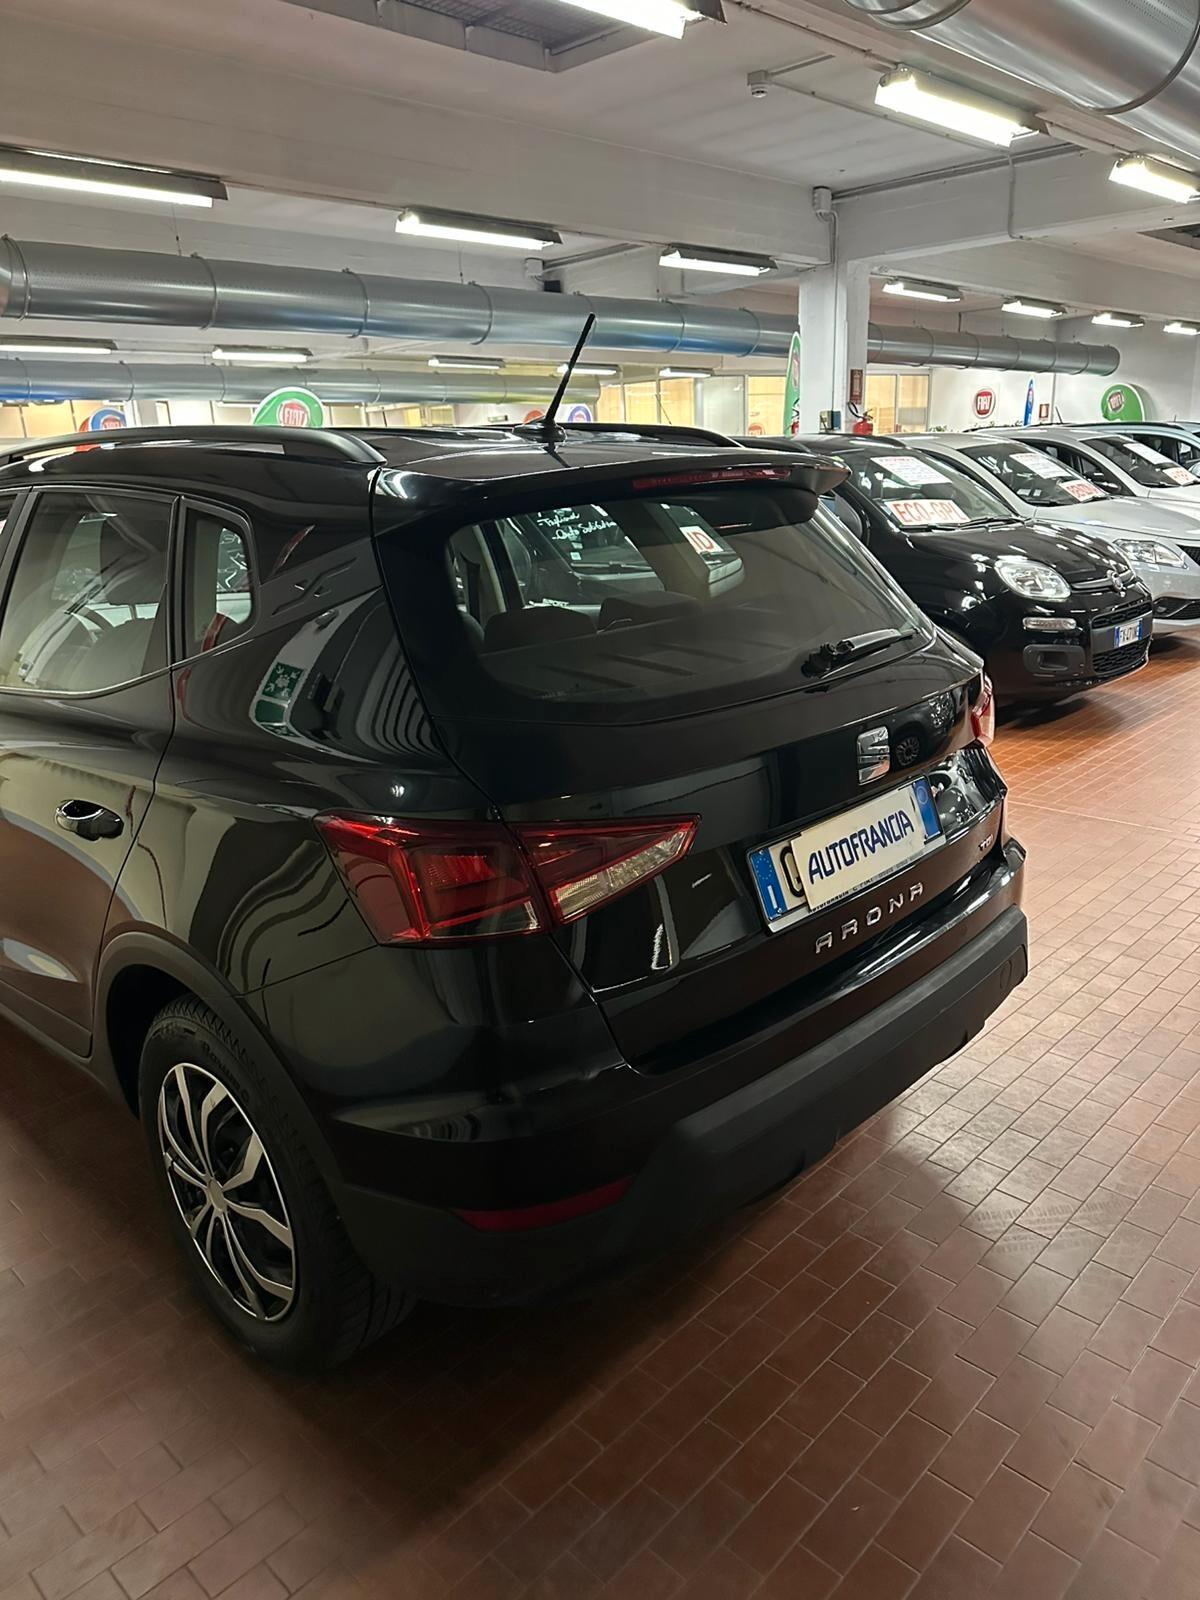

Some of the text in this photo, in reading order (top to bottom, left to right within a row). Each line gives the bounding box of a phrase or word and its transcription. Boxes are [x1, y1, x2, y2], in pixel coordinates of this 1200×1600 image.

[285, 408, 305, 425] FIAT
[892, 501, 968, 523] ECO-GPL
[808, 810, 915, 885] AUTOFRANCIA
[815, 882, 924, 954] ARONA
